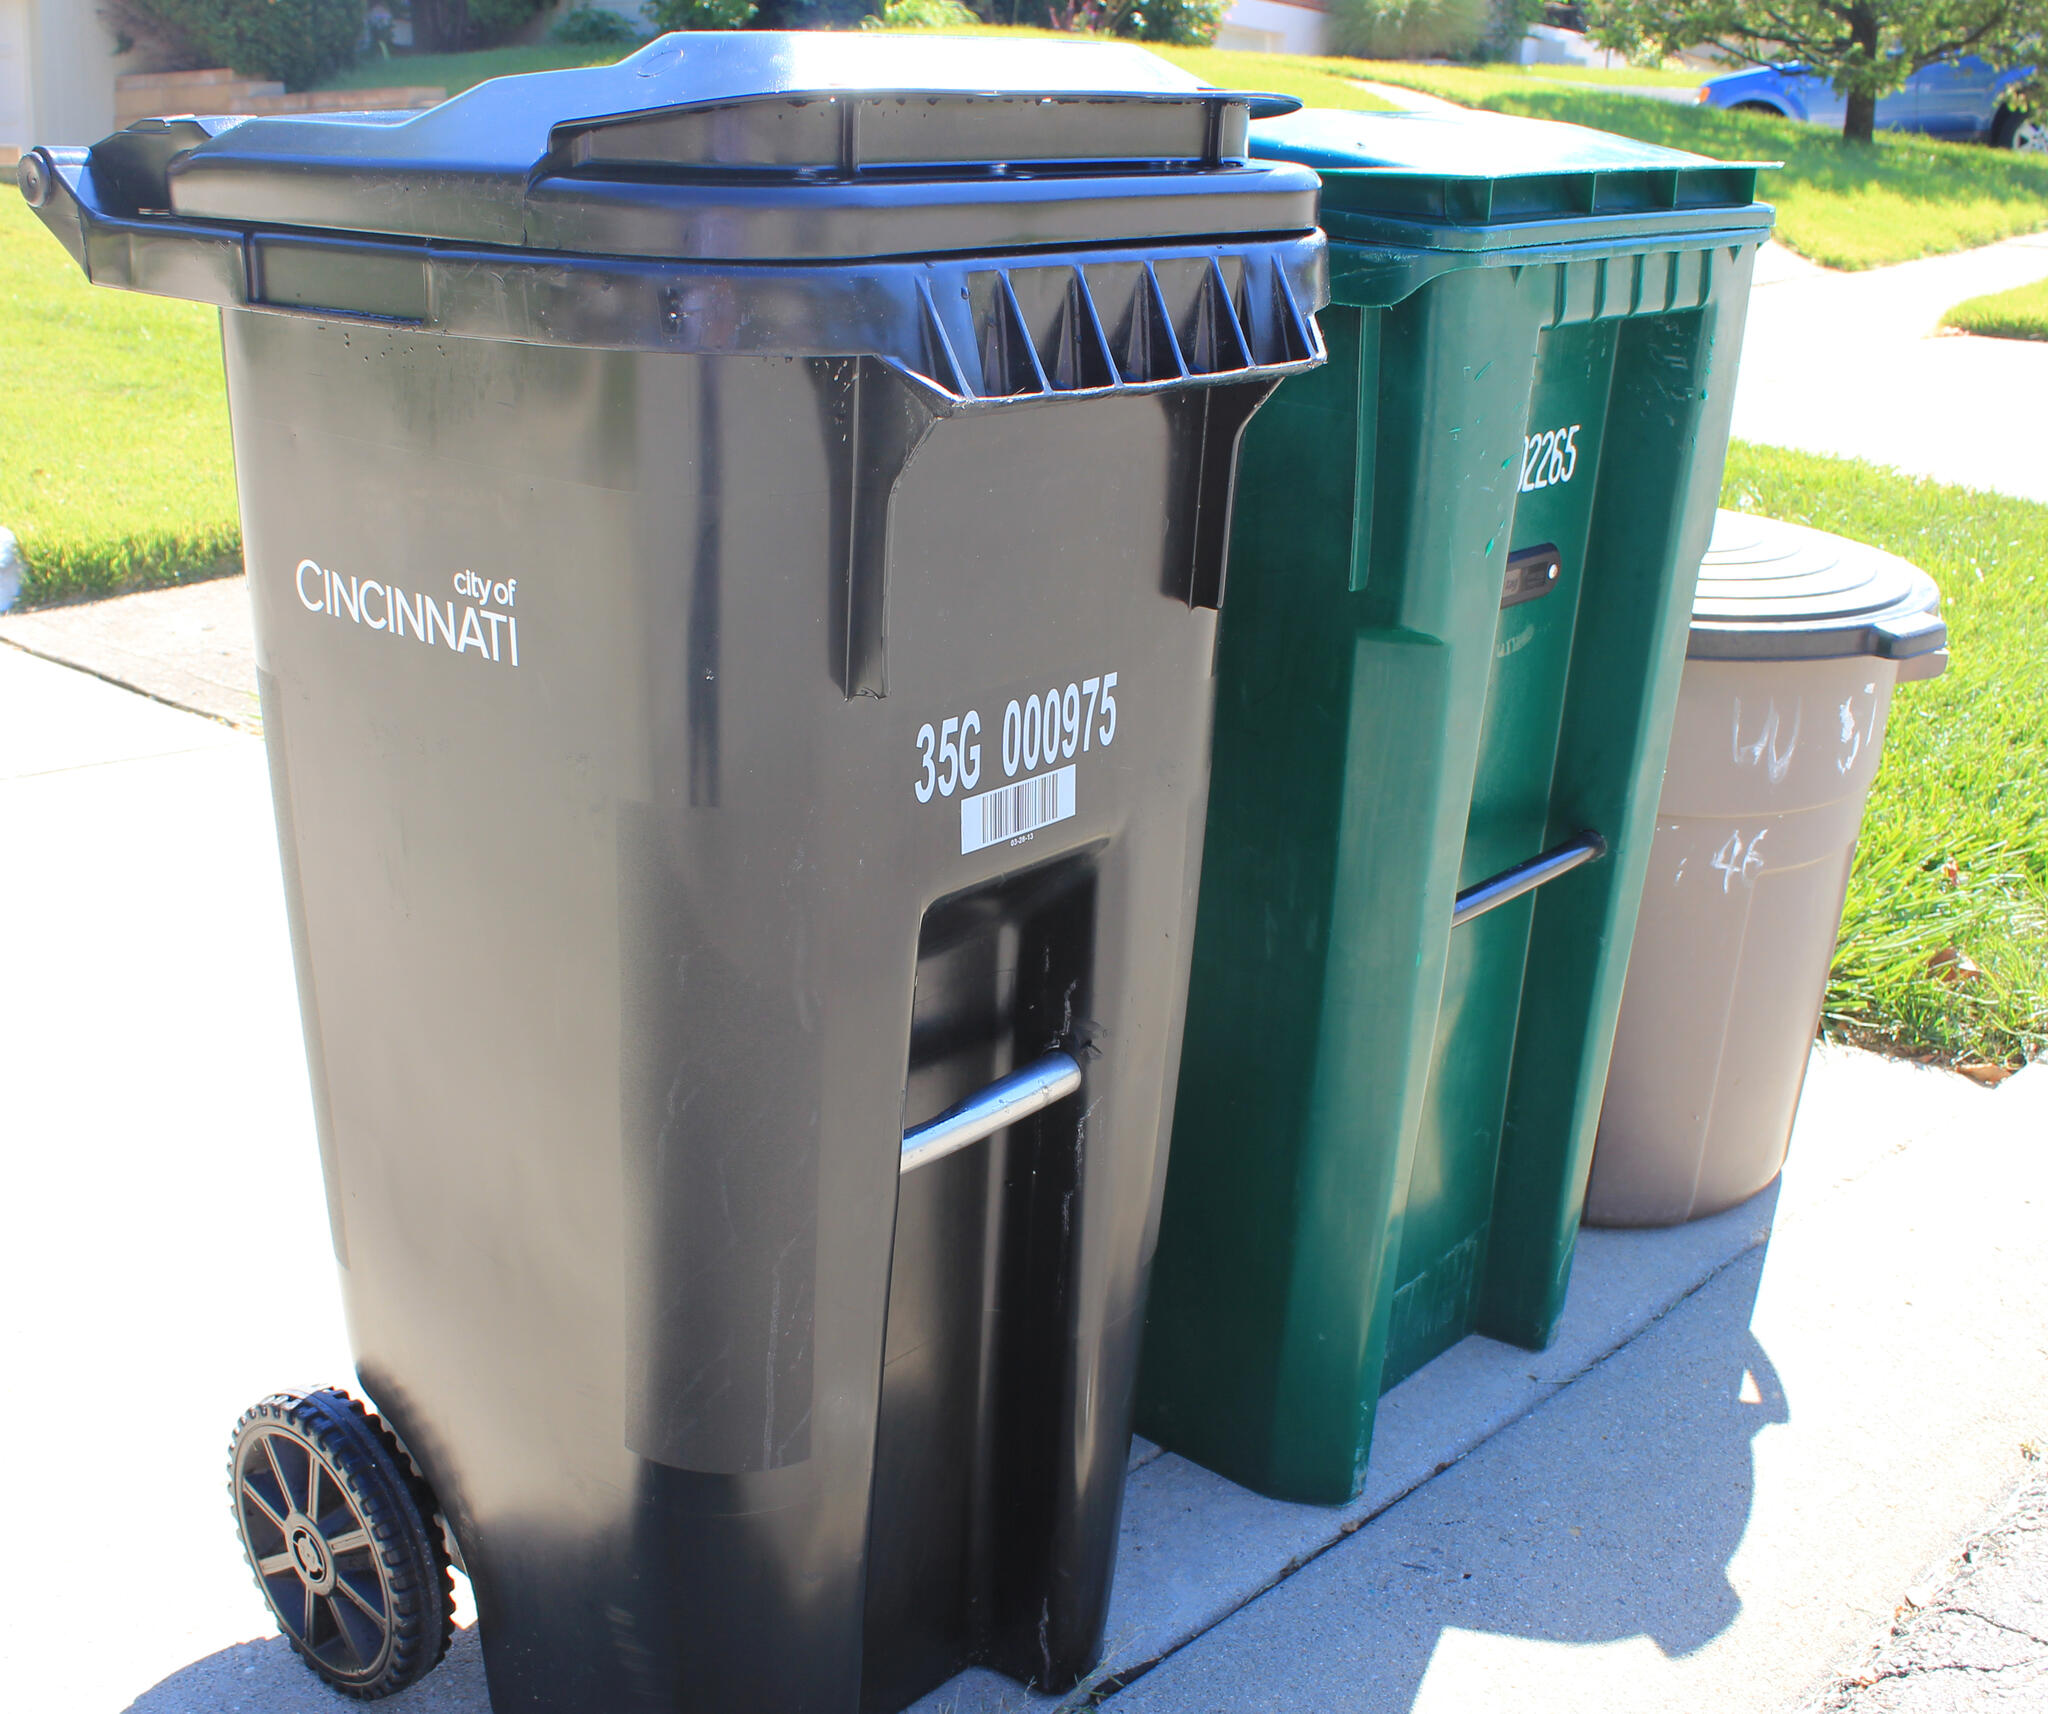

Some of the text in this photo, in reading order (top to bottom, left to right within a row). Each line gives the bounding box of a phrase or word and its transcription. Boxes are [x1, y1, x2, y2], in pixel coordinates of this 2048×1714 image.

[296, 558, 518, 667] CINCINNATI
[453, 568, 518, 607] city of
[914, 671, 1118, 804] 35G 000975
